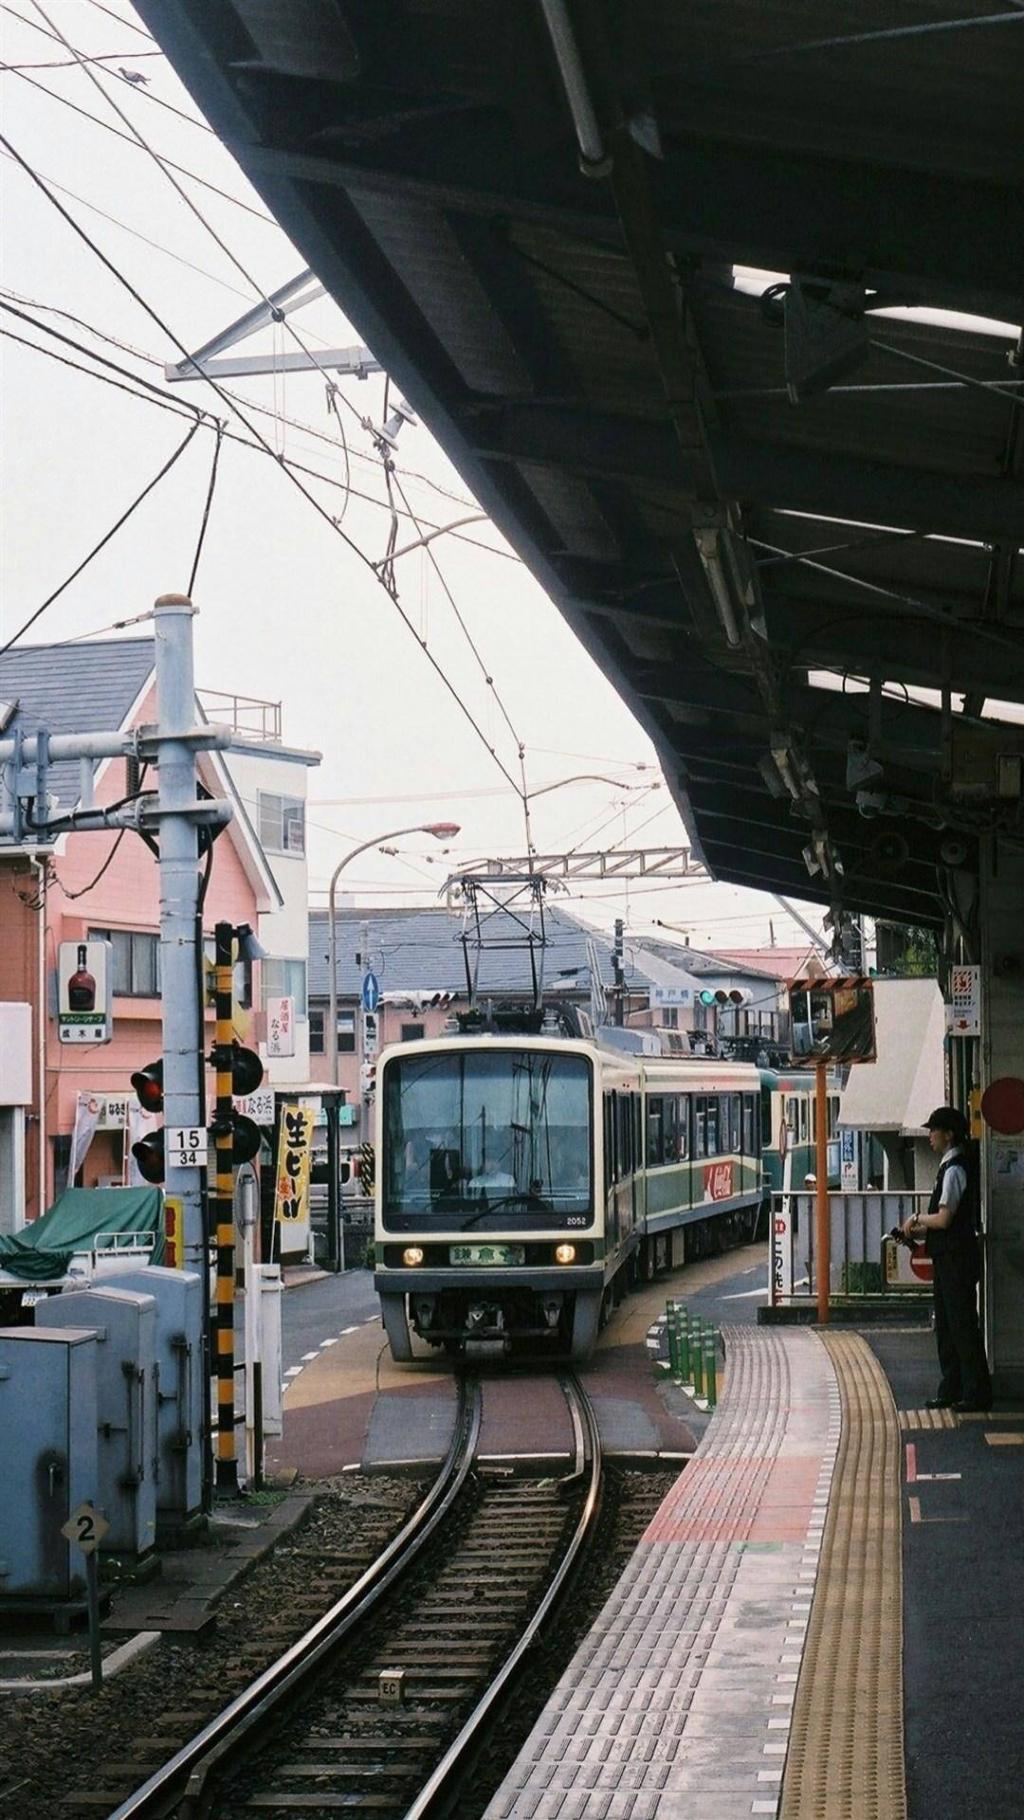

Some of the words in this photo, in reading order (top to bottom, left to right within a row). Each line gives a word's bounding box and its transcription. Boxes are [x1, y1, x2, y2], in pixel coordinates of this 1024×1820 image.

[178, 1131, 199, 1148] 15
[181, 1153, 196, 1164] 34
[283, 1111, 308, 1219] 生ビール
[567, 1216, 587, 1226] 2052
[77, 1515, 95, 1541] 2
[383, 1682, 397, 1695] EC
